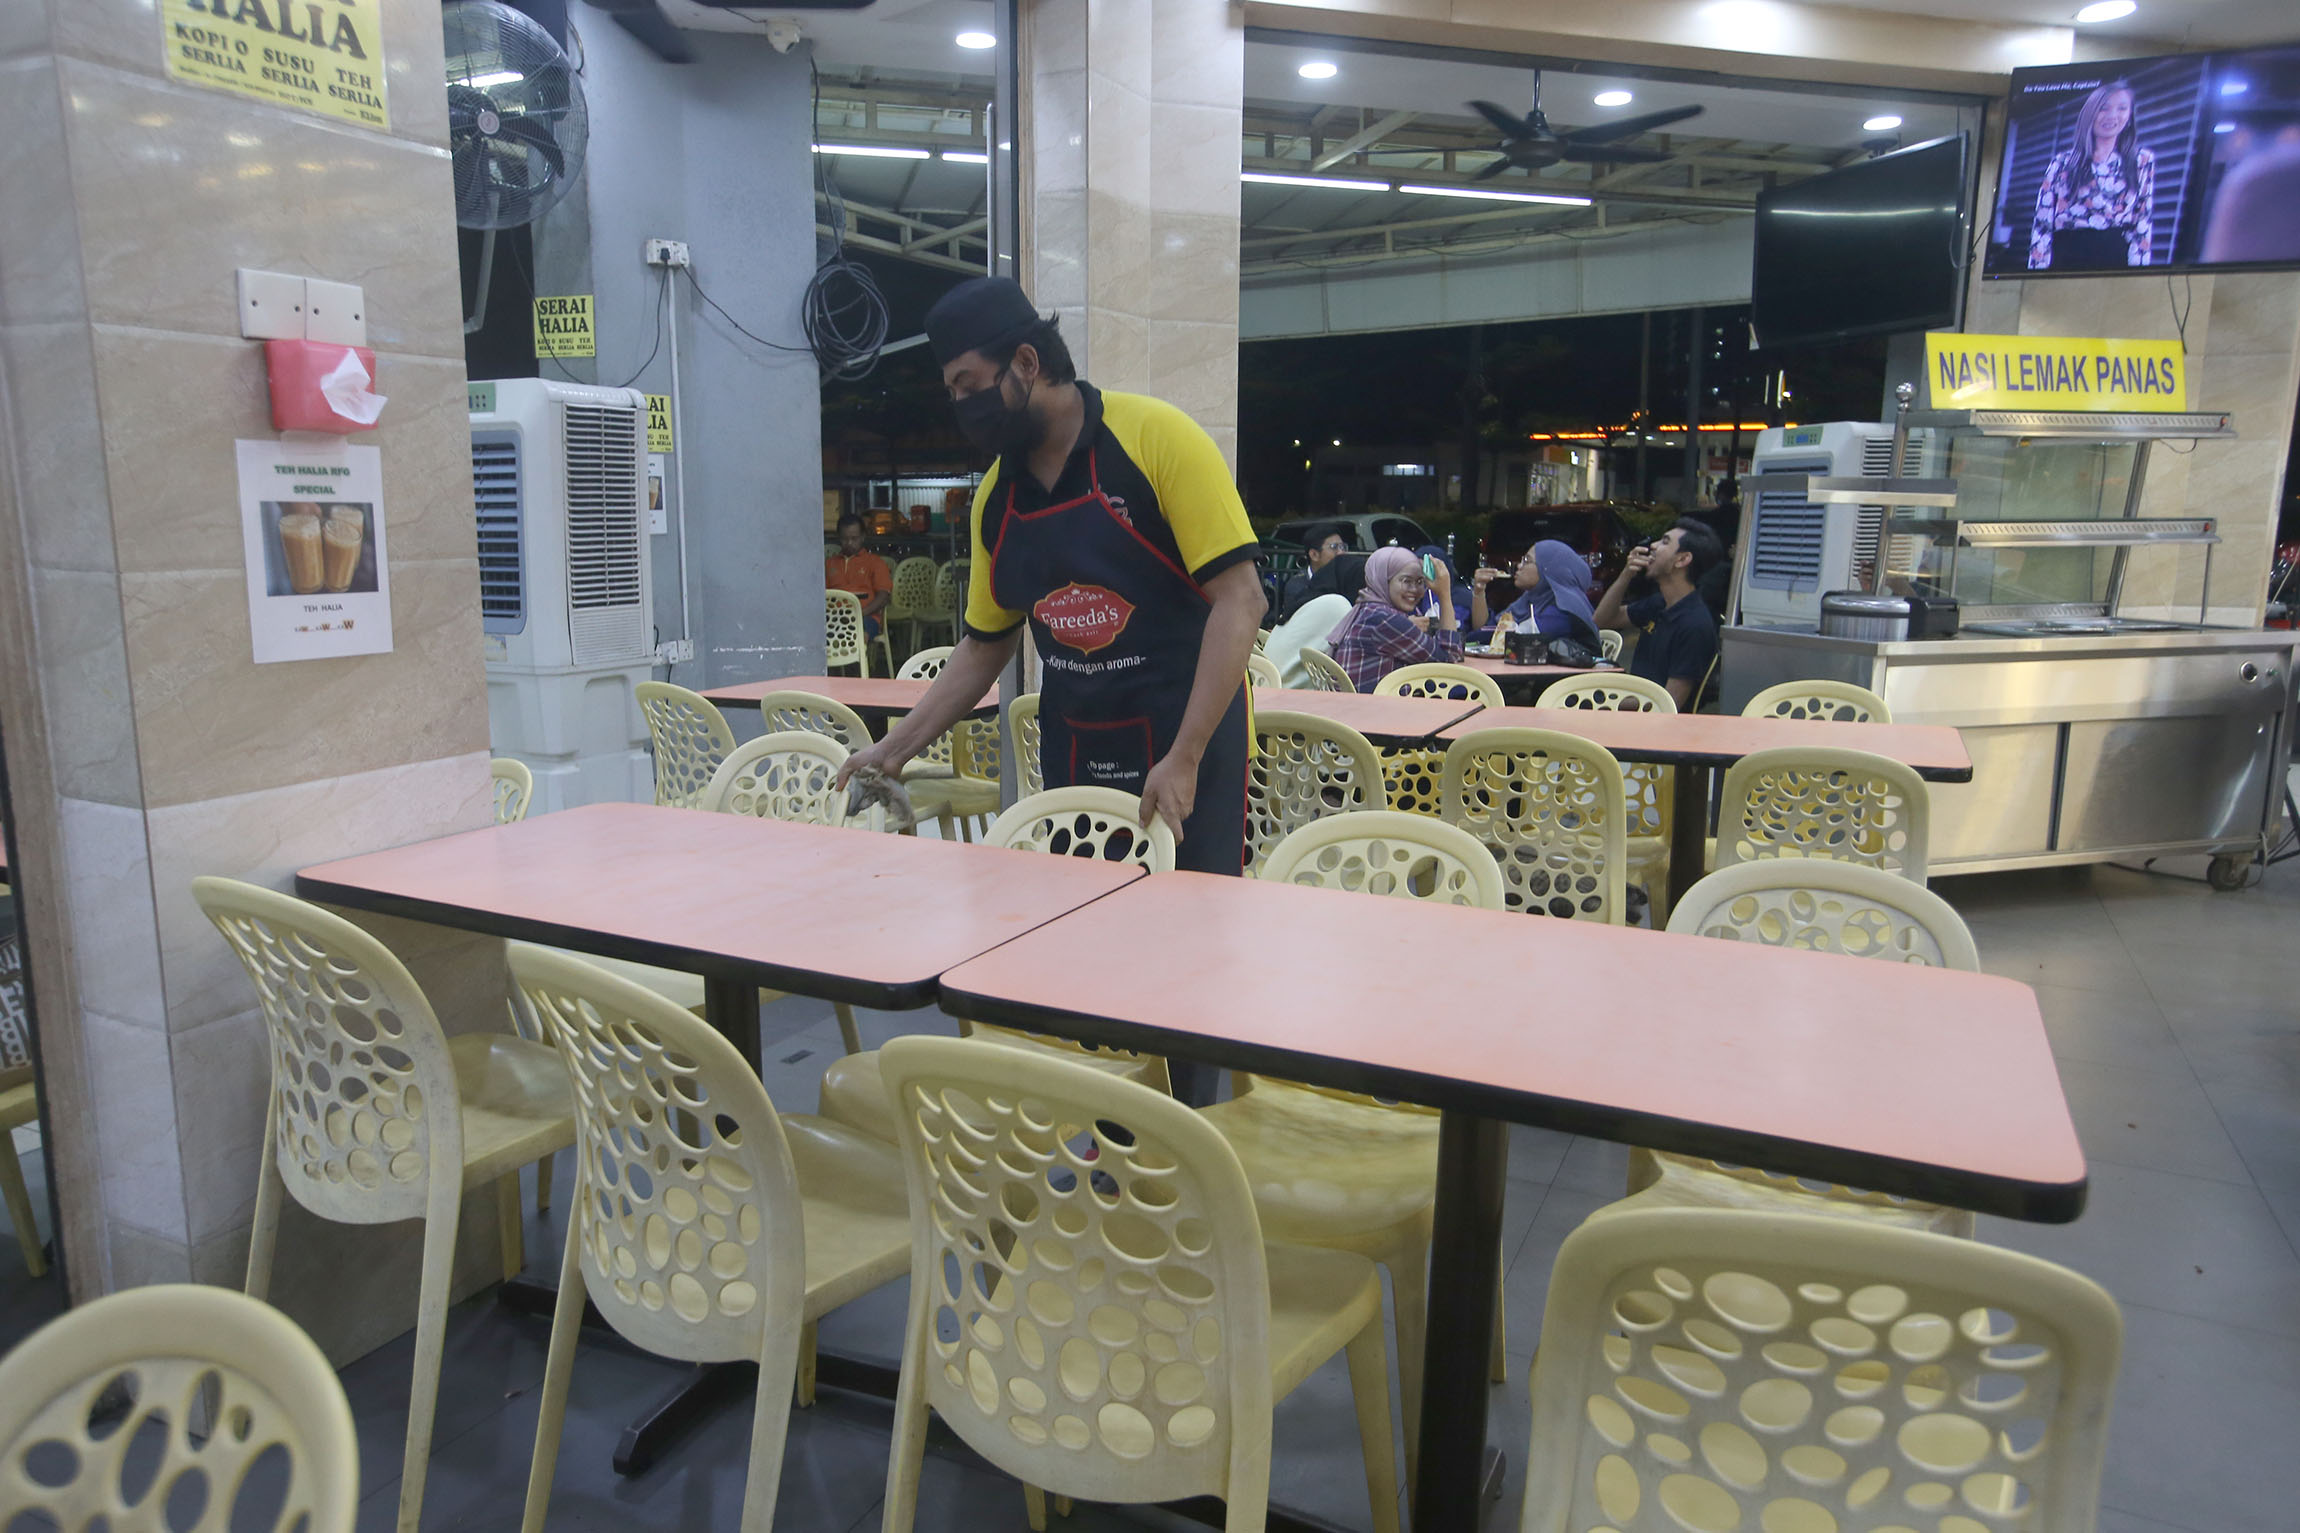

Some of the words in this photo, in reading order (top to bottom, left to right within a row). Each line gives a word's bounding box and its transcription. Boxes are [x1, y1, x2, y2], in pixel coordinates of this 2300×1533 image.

[175, 22, 229, 50] KOPI
[235, 40, 249, 55] O
[263, 48, 315, 74] SUSU
[335, 68, 373, 90] TEH
[181, 45, 247, 74] SERLIA
[261, 66, 320, 93] SERLIA
[328, 83, 383, 110] SERLIA
[540, 298, 587, 315] SERAI
[539, 317, 590, 334] HALIA
[1939, 352, 1997, 391] NASI
[2005, 354, 2090, 392] LEMAK
[2096, 356, 2176, 395] PANAS
[274, 465, 296, 475] TEH
[297, 465, 328, 476] HALIA
[293, 484, 336, 495] SPECIAL
[303, 605, 318, 613] TEH
[321, 603, 344, 612] HALIA
[1040, 604, 1119, 630] Fareeda's
[1067, 659, 1105, 675] dengan
[1098, 762, 1115, 771] page
